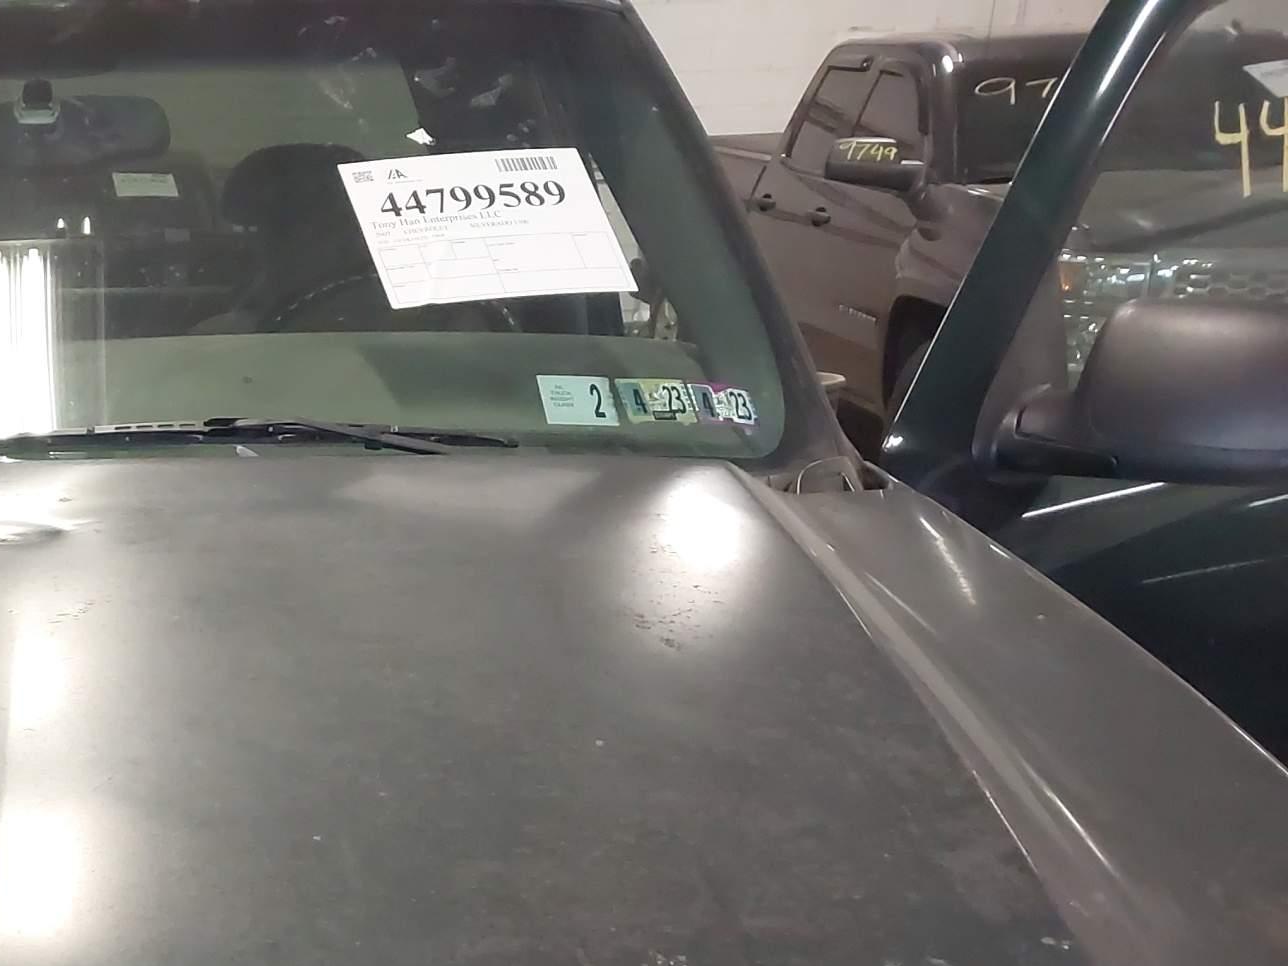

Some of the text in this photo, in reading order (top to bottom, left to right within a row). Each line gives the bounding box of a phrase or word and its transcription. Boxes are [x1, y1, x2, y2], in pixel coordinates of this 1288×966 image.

[839, 141, 898, 161] 9749
[380, 180, 565, 217] 44799589
[371, 209, 502, 230] Tony Han Enterprises LLC
[589, 383, 607, 418] 2
[632, 385, 686, 414] 4 23
[729, 392, 752, 420] 23
